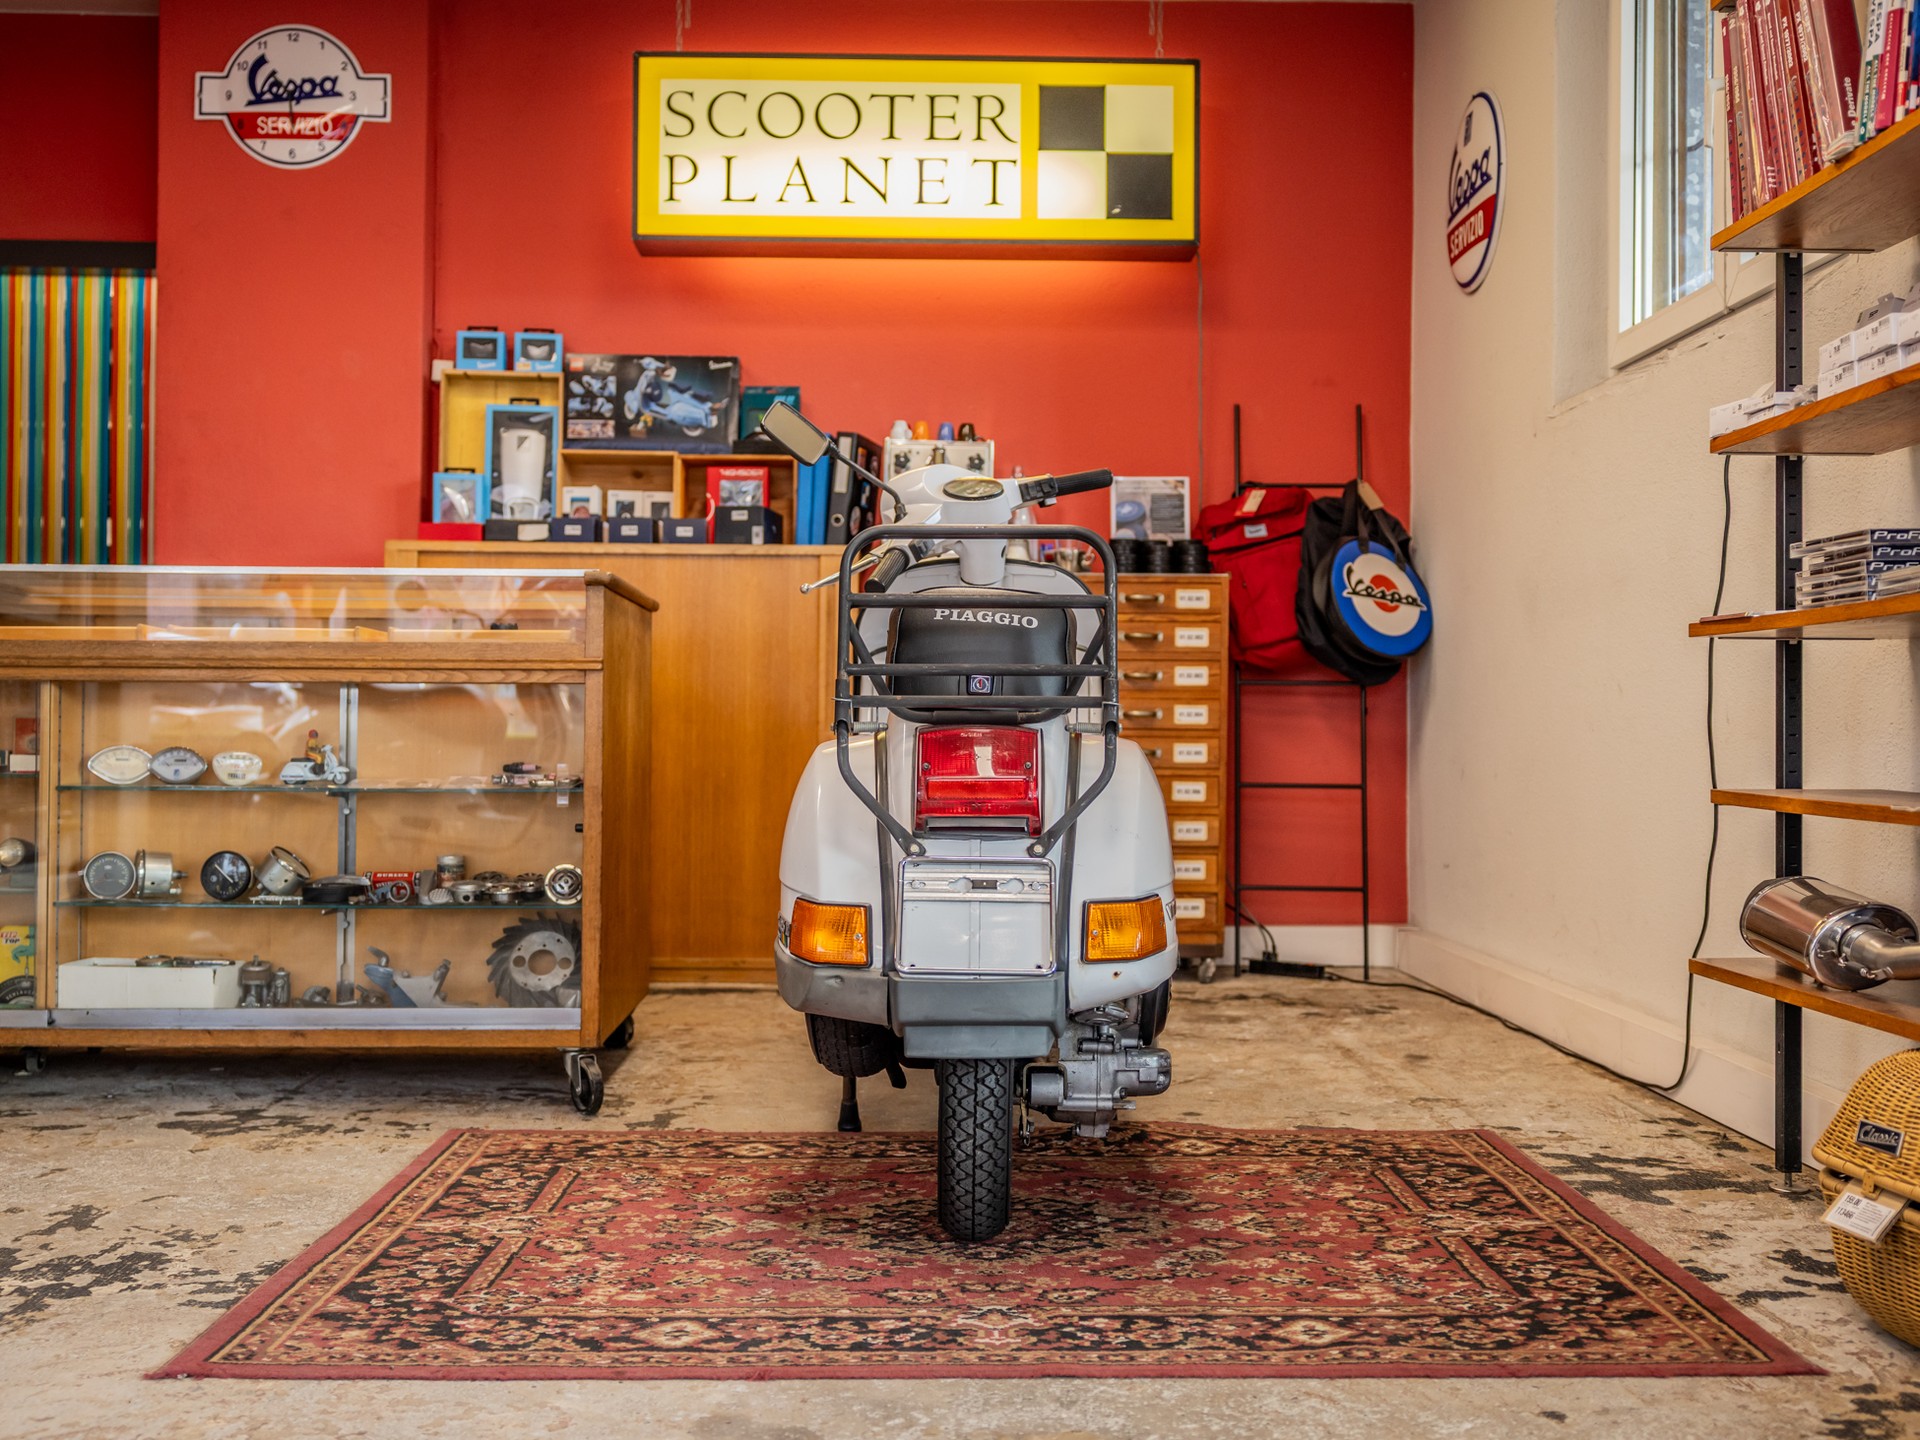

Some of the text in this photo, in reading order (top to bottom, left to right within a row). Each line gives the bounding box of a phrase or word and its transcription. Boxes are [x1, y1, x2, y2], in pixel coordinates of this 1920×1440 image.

[287, 33, 299, 43] 12
[1781, 16, 1794, 69] PX 1977/2002
[257, 41, 268, 49] 11
[320, 41, 325, 50] 1
[237, 61, 249, 71] 10
[341, 61, 348, 71] 2
[244, 52, 344, 105] Vespa
[226, 91, 232, 101] 9
[350, 91, 357, 101] 3
[1844, 76, 1857, 118] Derivate
[663, 90, 1018, 144] SCOOTER
[260, 141, 267, 151] 7
[318, 142, 325, 151] 5
[289, 150, 296, 159] 6
[663, 154, 1018, 207] PLANET
[1450, 209, 1485, 258] SERVIZIO
[1873, 530, 1920, 540] ProF
[1345, 565, 1425, 609] Vespa
[933, 608, 1039, 629] PIAGGIO
[1858, 1125, 1899, 1146] Classic
